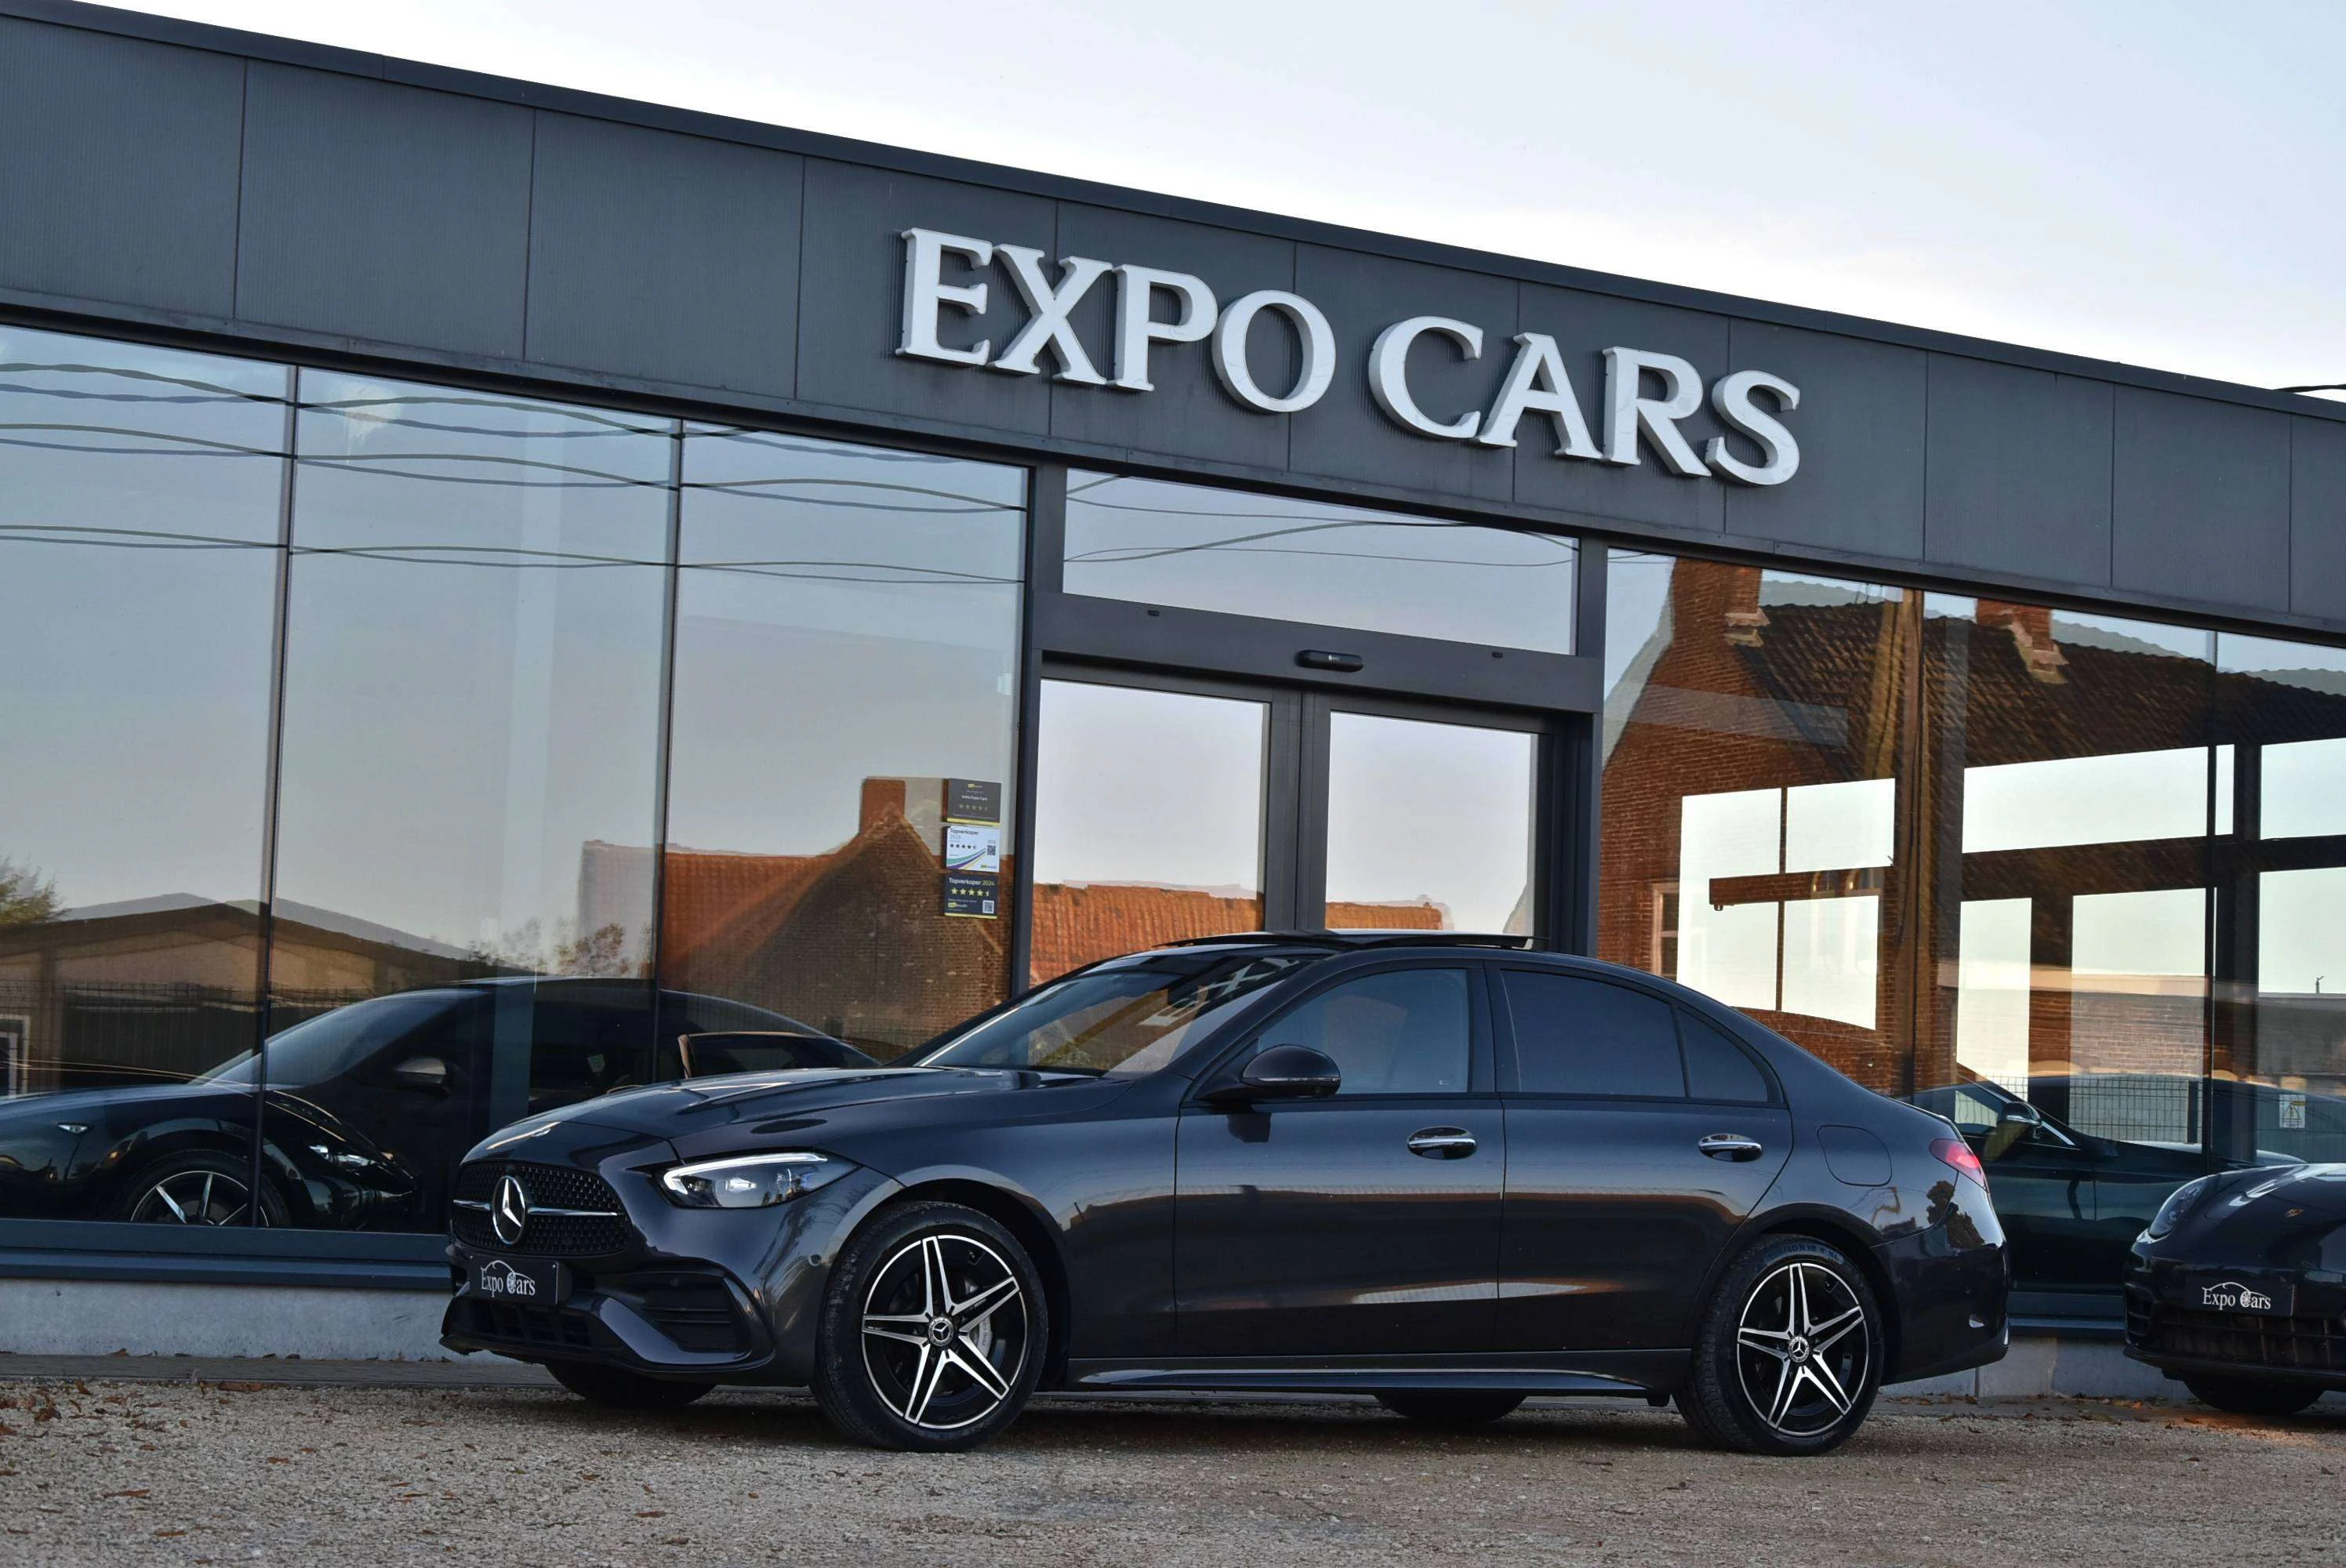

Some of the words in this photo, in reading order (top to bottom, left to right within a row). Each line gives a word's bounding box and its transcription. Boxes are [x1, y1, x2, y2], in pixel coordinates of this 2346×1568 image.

[896, 227, 1336, 413] EXPO
[1369, 316, 1800, 485] CARS
[481, 1268, 503, 1298] Expo
[507, 1272, 536, 1296] Cars
[2202, 1288, 2235, 1311] Expo
[2240, 1290, 2272, 1309] Cars
